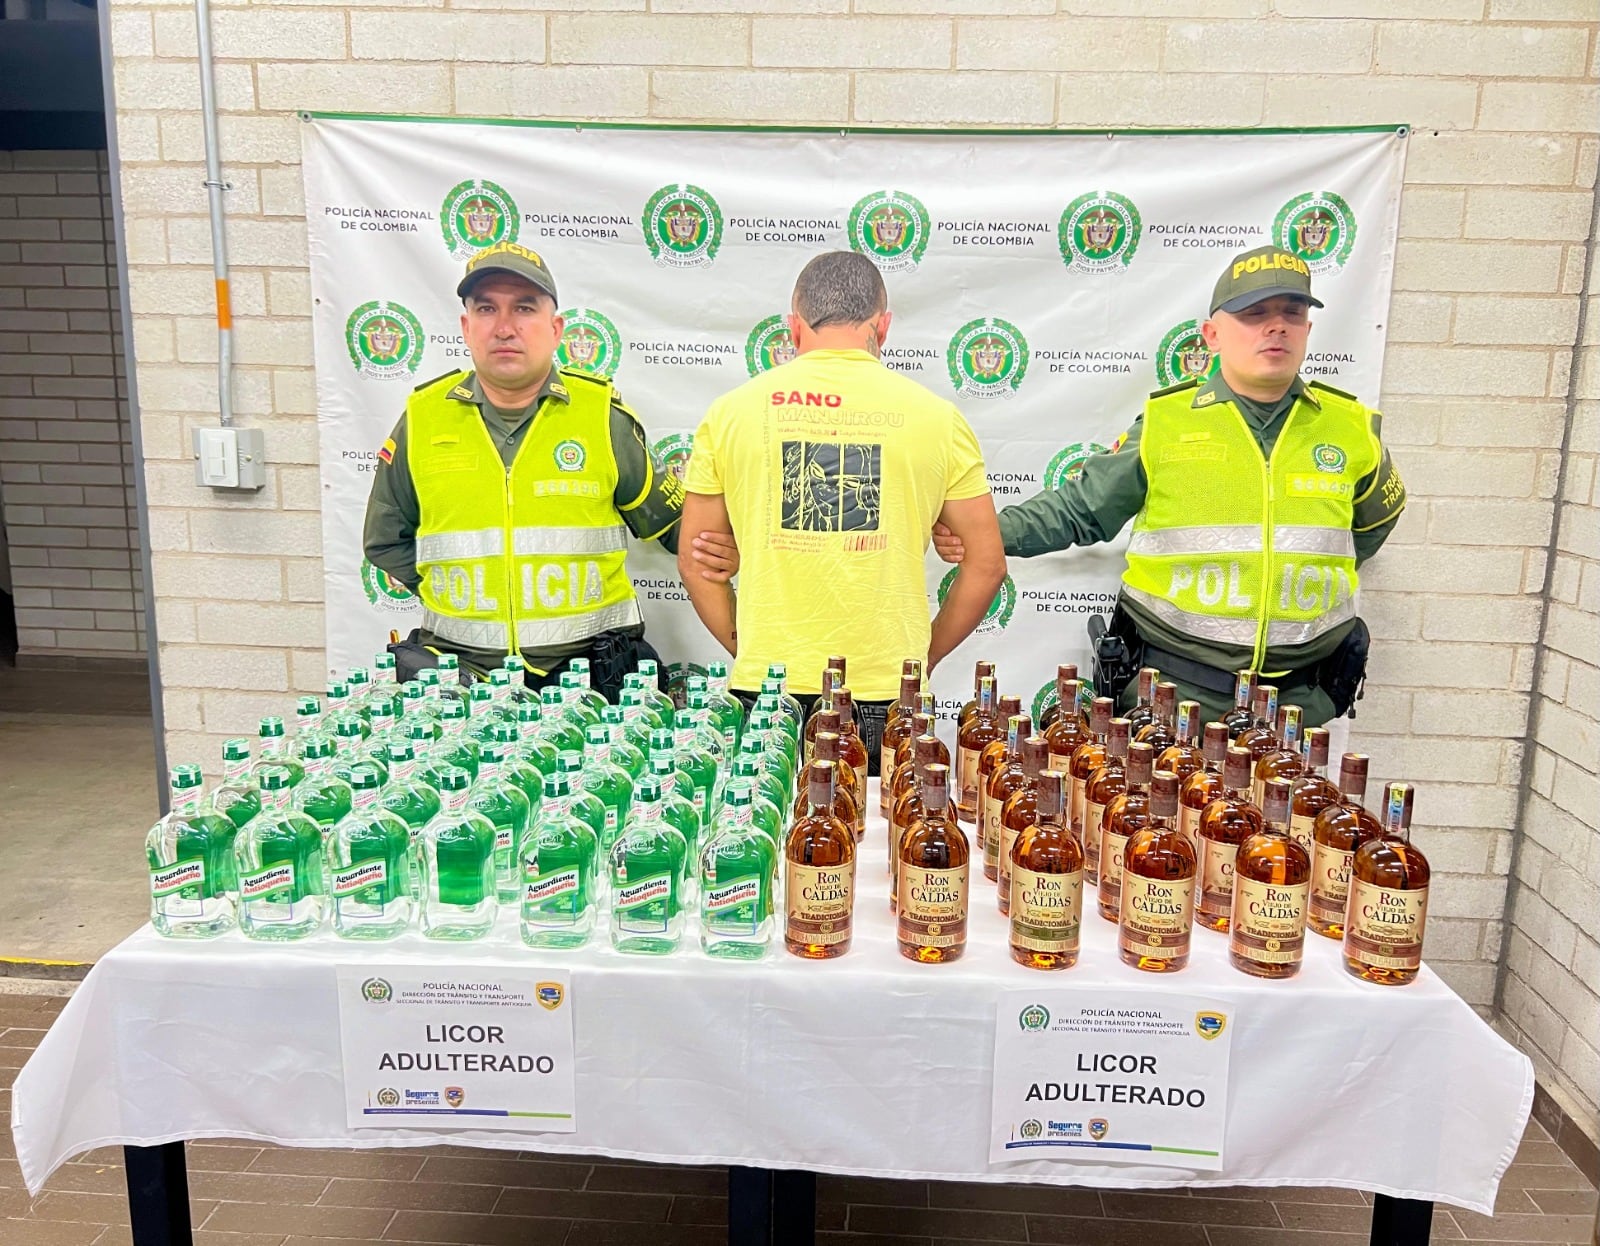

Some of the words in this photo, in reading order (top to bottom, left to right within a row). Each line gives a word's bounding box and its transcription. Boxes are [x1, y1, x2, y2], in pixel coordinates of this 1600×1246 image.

[325, 207, 371, 218] POLICÍA
[374, 210, 435, 220] NACIONAL
[525, 212, 570, 224] POLICÍA
[573, 215, 633, 225] NACIONAL
[341, 220, 357, 231] DE
[359, 222, 418, 232] COLOMBIA
[730, 217, 776, 228] POLICÍA
[779, 219, 841, 230] NACIONAL
[938, 221, 985, 231] POLICÍA
[988, 222, 1051, 233] NACIONAL
[1149, 223, 1195, 234] POLICÍA
[1199, 225, 1263, 235] NACIONAL
[540, 226, 556, 237] DE
[558, 228, 618, 239] COLOMBIA
[745, 232, 761, 241] DE
[764, 233, 825, 242] COLOMBIA
[953, 236, 969, 245] DE
[971, 236, 1034, 246] COLOMBIA
[1163, 239, 1179, 248] DE
[1182, 239, 1246, 248] COLOMBIA
[1233, 253, 1309, 279] POLICIA
[430, 335, 464, 344] POLIC
[446, 348, 460, 357] DE
[630, 341, 674, 352] POLICÍA
[677, 343, 738, 354] NACIONAL
[645, 356, 659, 364] DE
[662, 356, 723, 366] COLOMBIA
[1035, 349, 1081, 360] POLICÍA
[1085, 351, 1148, 361] NACIONAL
[1306, 353, 1356, 362] ACIONAL
[886, 362, 923, 370] OMBIA
[1050, 364, 1065, 373] DE
[1068, 364, 1131, 374] COLOMBIA
[1298, 366, 1339, 375] LOMBIA
[771, 391, 842, 408] SANO
[777, 408, 904, 428] MANJIROU
[986, 473, 1037, 482] ACIONAL
[990, 486, 1021, 494] MBIA
[431, 565, 497, 611] POL
[521, 561, 603, 610] ICIA
[633, 578, 676, 588] POLICÍA
[647, 591, 662, 600] DE
[1022, 591, 1067, 600] POLICÍA
[1070, 592, 1116, 602] NACION
[1036, 604, 1051, 612] DE
[1054, 604, 1115, 614] COLOMBIA
[154, 864, 200, 883] Aguardiente
[244, 867, 290, 887] Aguardiente
[335, 864, 382, 883] Aguardiente
[817, 872, 841, 884] RON
[925, 873, 949, 886] RON
[154, 872, 201, 890] Antioqueño
[243, 875, 291, 894] Antioqueño
[335, 872, 383, 890] Antioqueño
[527, 873, 576, 893] Aguardiente
[1036, 877, 1061, 890] RON
[527, 880, 577, 900] Antioqueño
[619, 879, 667, 898] Aguardiente
[709, 881, 756, 901] Aguardiente
[803, 887, 848, 901] CALDAS
[911, 887, 959, 902] CALDAS
[1147, 883, 1173, 897] RON
[1266, 888, 1292, 902] RON
[618, 886, 668, 906] Antioqueño
[708, 888, 757, 908] Antioqueño
[1022, 891, 1071, 907] CALDAS
[1380, 892, 1407, 906] RON
[1132, 896, 1182, 914] CALDAS
[1250, 901, 1300, 918] CALDAS
[801, 910, 848, 921] TRADICIONAL
[909, 912, 959, 922] TRADICIONAL
[1363, 905, 1415, 924] CALDAS
[1021, 916, 1071, 927] TRADICIONAL
[1130, 920, 1181, 934] TRADICIONAL
[1246, 926, 1299, 938] TRADICIONAL
[1359, 929, 1414, 943] TRADICIONAL
[423, 982, 456, 990] POLICÍA
[1081, 1008, 1115, 1017] POLICÍA
[1117, 1010, 1163, 1019] NACIONAL
[1104, 1019, 1135, 1027] TRÁNSITO
[426, 1024, 504, 1044] LICOR
[379, 1053, 554, 1074] ADULTERADO
[1077, 1053, 1157, 1075] LICOR
[1025, 1083, 1205, 1108] ADULTERADO
